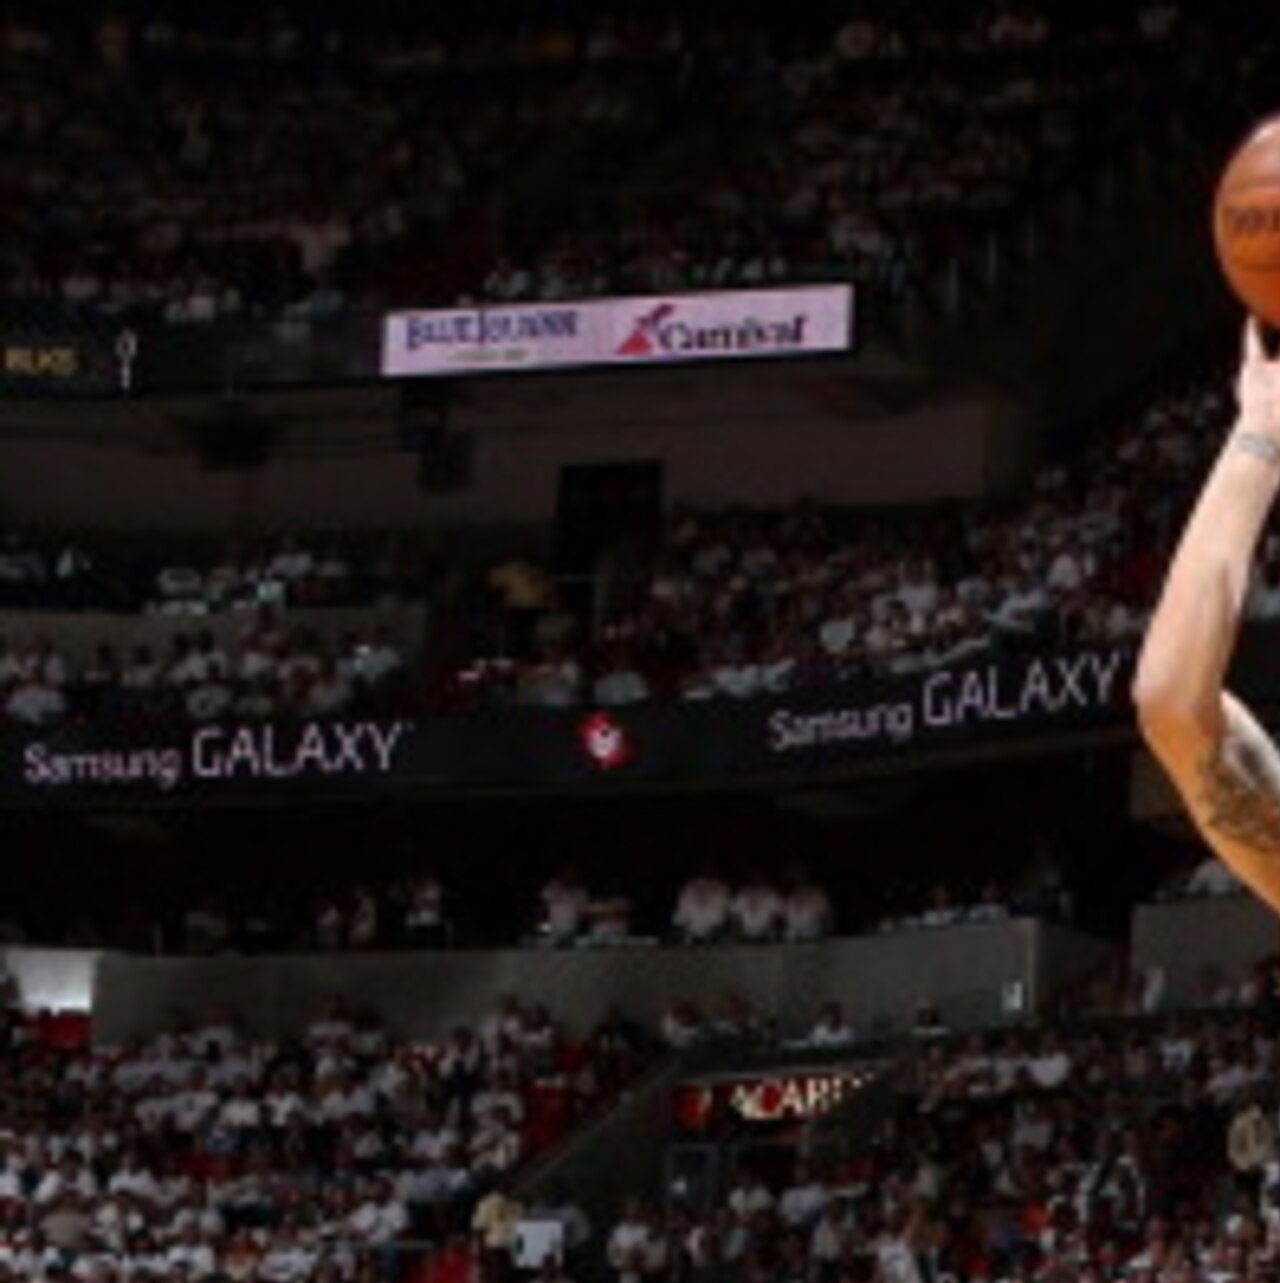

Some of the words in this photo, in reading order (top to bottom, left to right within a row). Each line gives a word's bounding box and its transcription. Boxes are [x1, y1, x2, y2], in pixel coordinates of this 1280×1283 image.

[768, 702, 914, 752] Samsung
[922, 650, 1121, 727] GALAXY
[24, 741, 184, 791] Samsung
[190, 721, 403, 779] GALAXY
